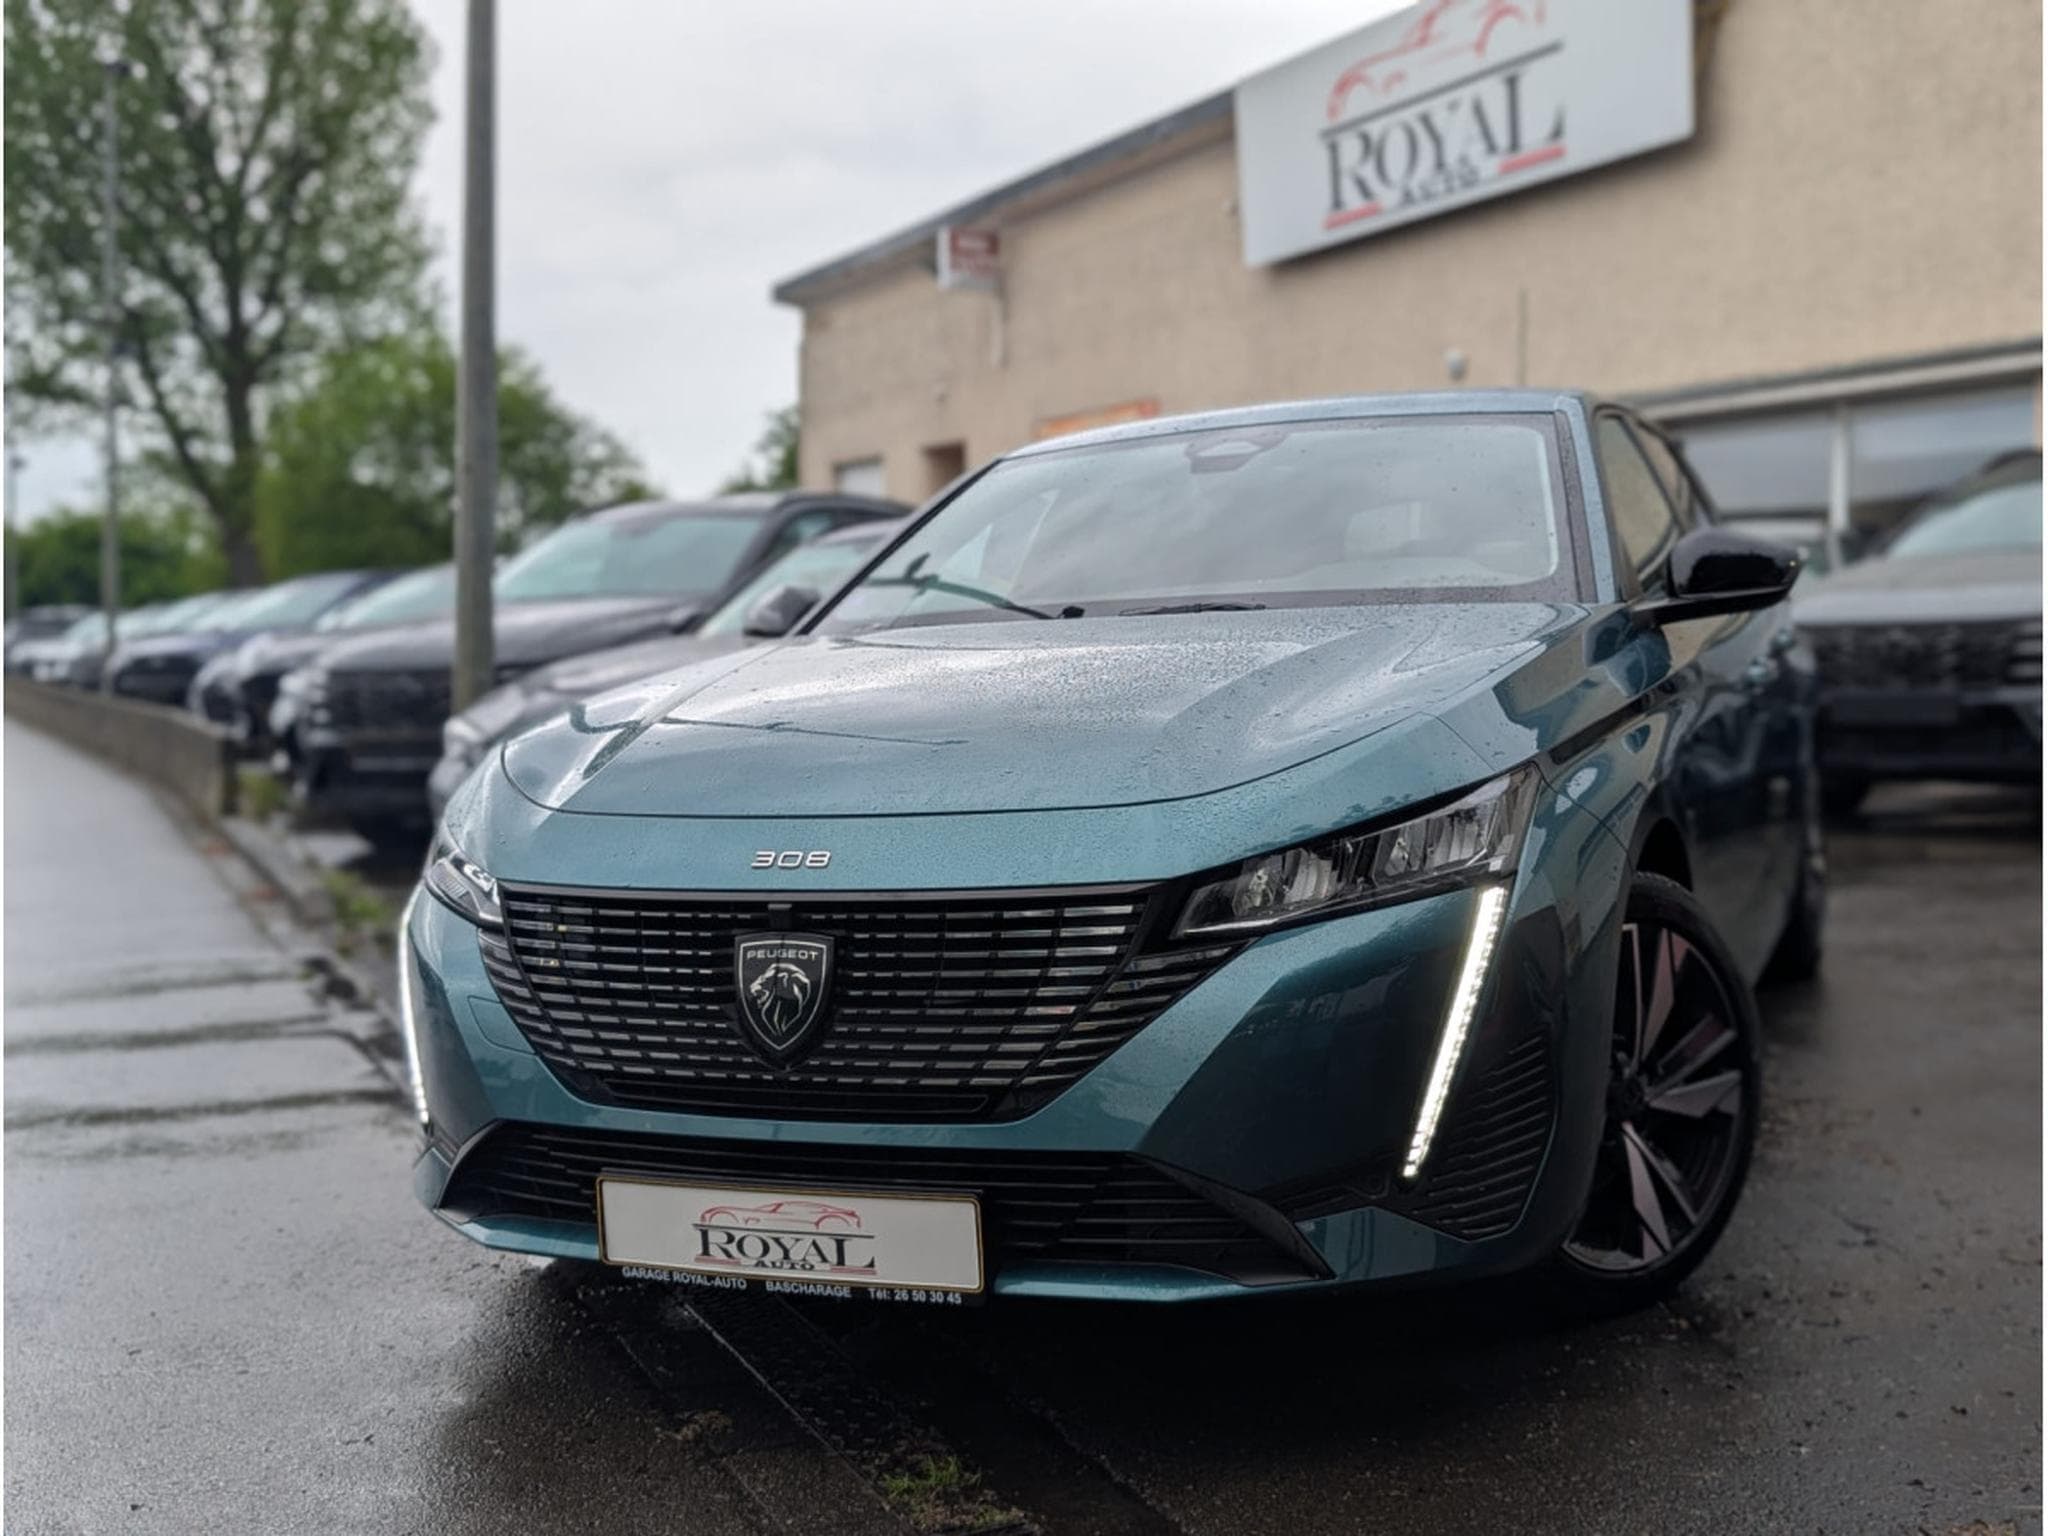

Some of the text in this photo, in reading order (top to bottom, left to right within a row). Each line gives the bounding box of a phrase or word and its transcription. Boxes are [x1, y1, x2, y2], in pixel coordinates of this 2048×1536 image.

[1324, 69, 1566, 210] ROYAL
[1402, 153, 1480, 206] AUTO
[751, 850, 831, 868] 308
[747, 948, 819, 961] PEUGEOT
[698, 1228, 875, 1268] ROYAL
[755, 1259, 815, 1271] AUTO
[622, 1266, 670, 1281] GARAGE
[673, 1271, 747, 1290] ROYAL-AUTO
[765, 1280, 851, 1298] BASCHARAGE
[894, 1289, 908, 1301] 26
[912, 1290, 926, 1302] 50
[929, 1291, 943, 1303] 30
[947, 1292, 962, 1304] 45
